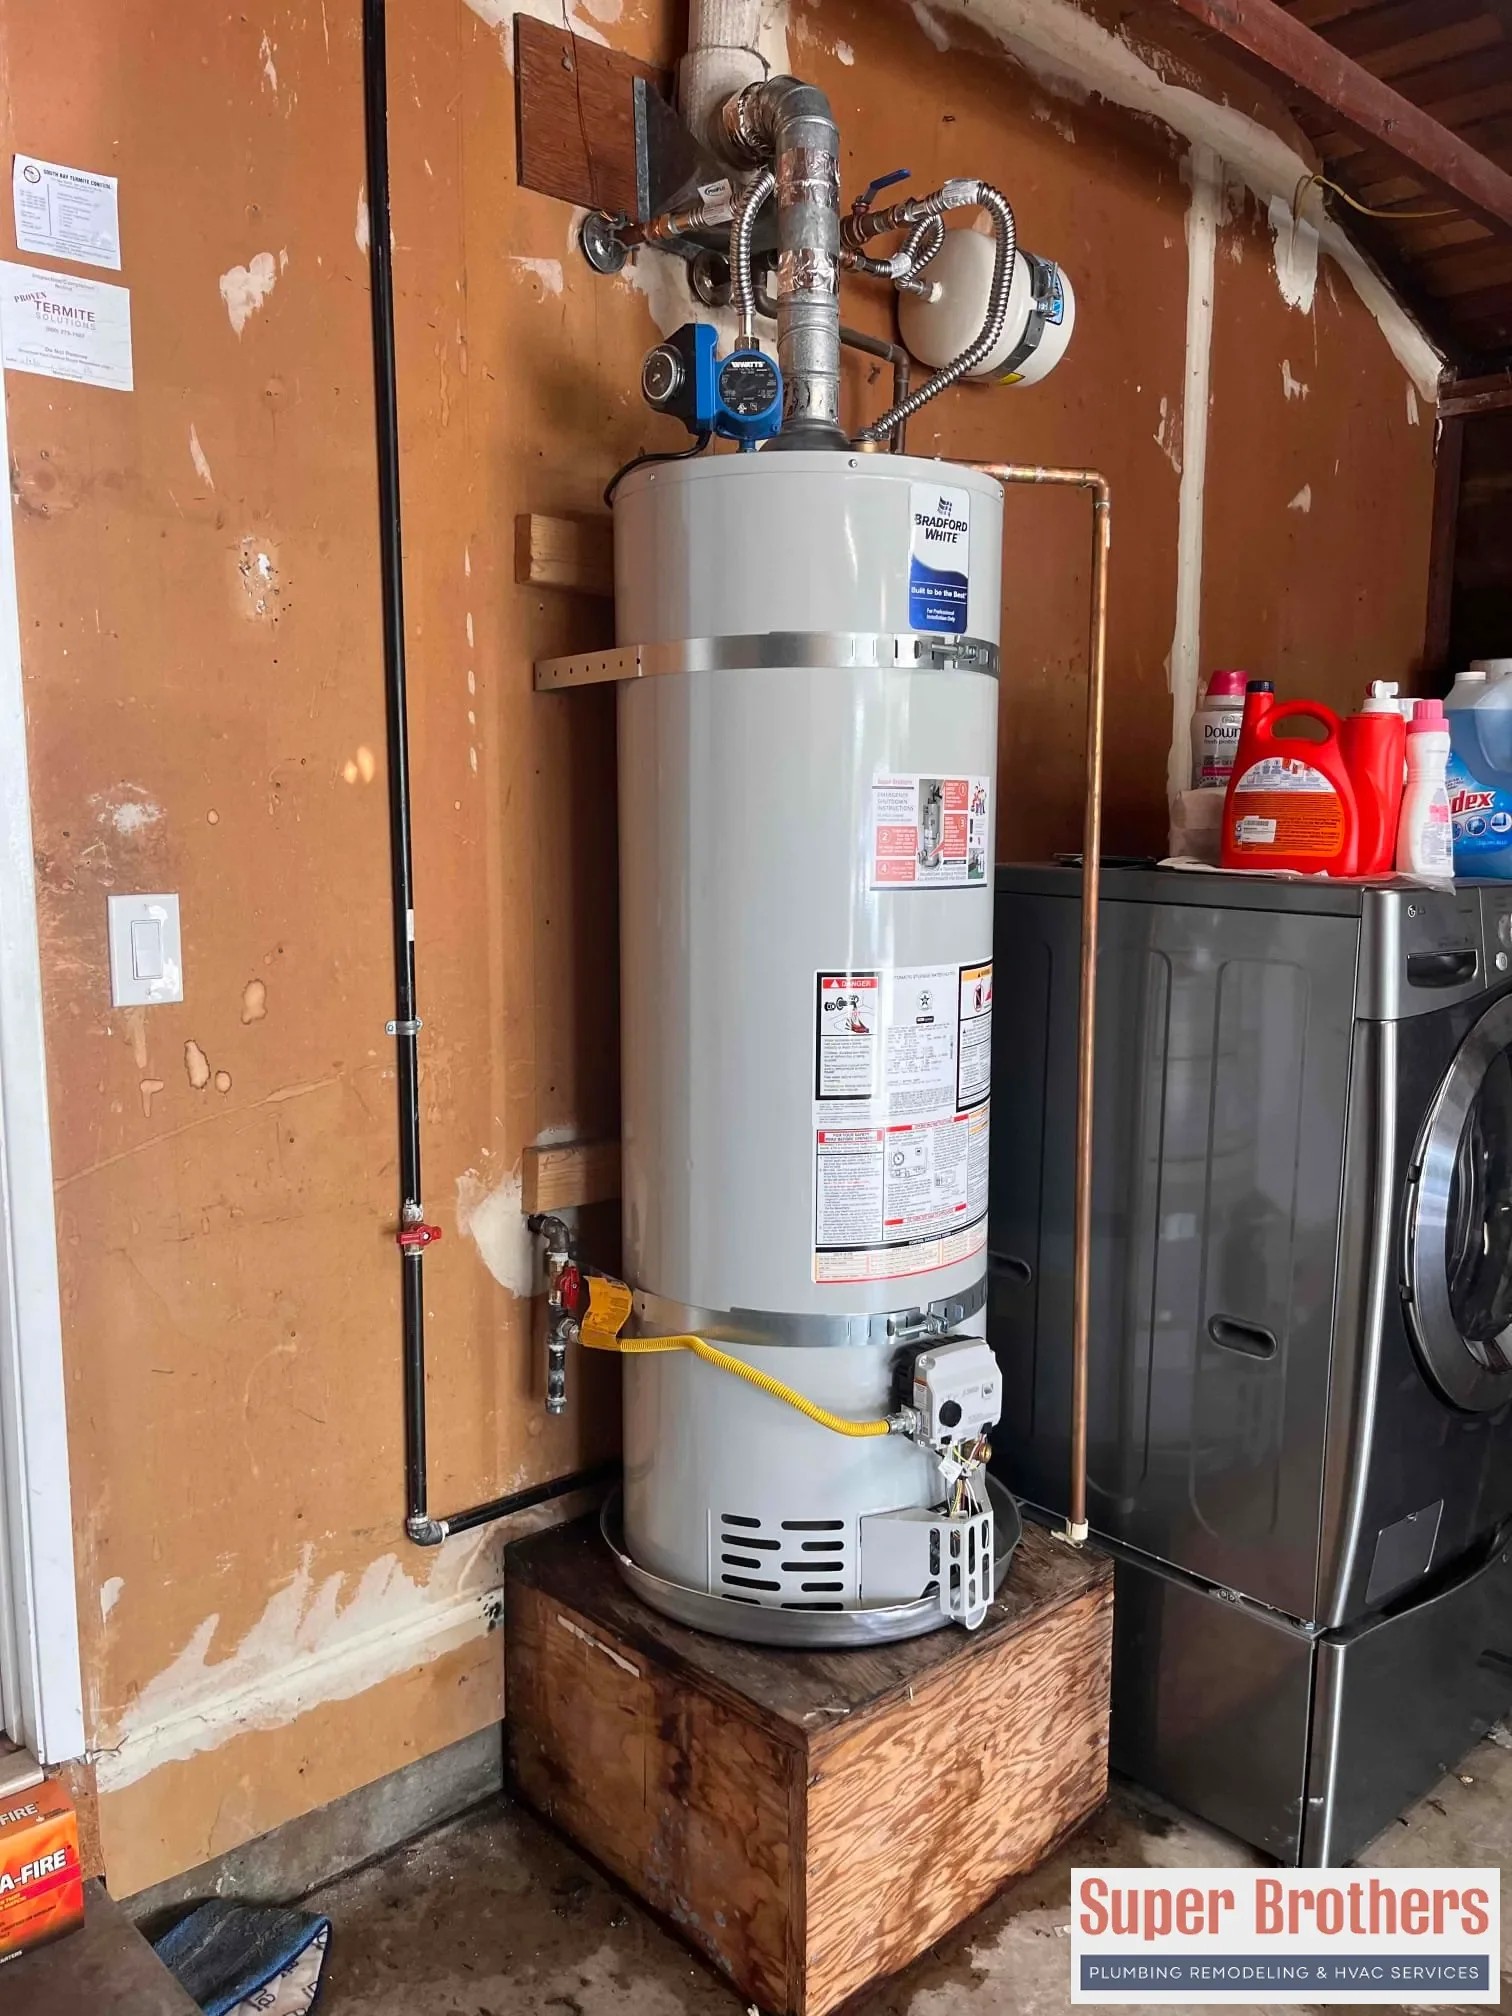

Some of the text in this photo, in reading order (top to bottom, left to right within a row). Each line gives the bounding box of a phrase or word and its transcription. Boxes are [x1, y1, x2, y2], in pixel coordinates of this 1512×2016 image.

[14, 291, 47, 304] PROVEN
[34, 300, 96, 322] TERMITE
[36, 312, 96, 331] SOLUTIONS
[914, 514, 968, 532] BRADFORD
[925, 528, 958, 544] WHITE
[911, 587, 926, 595] Built
[926, 588, 933, 596] to
[934, 588, 942, 596] be
[943, 589, 952, 597] the
